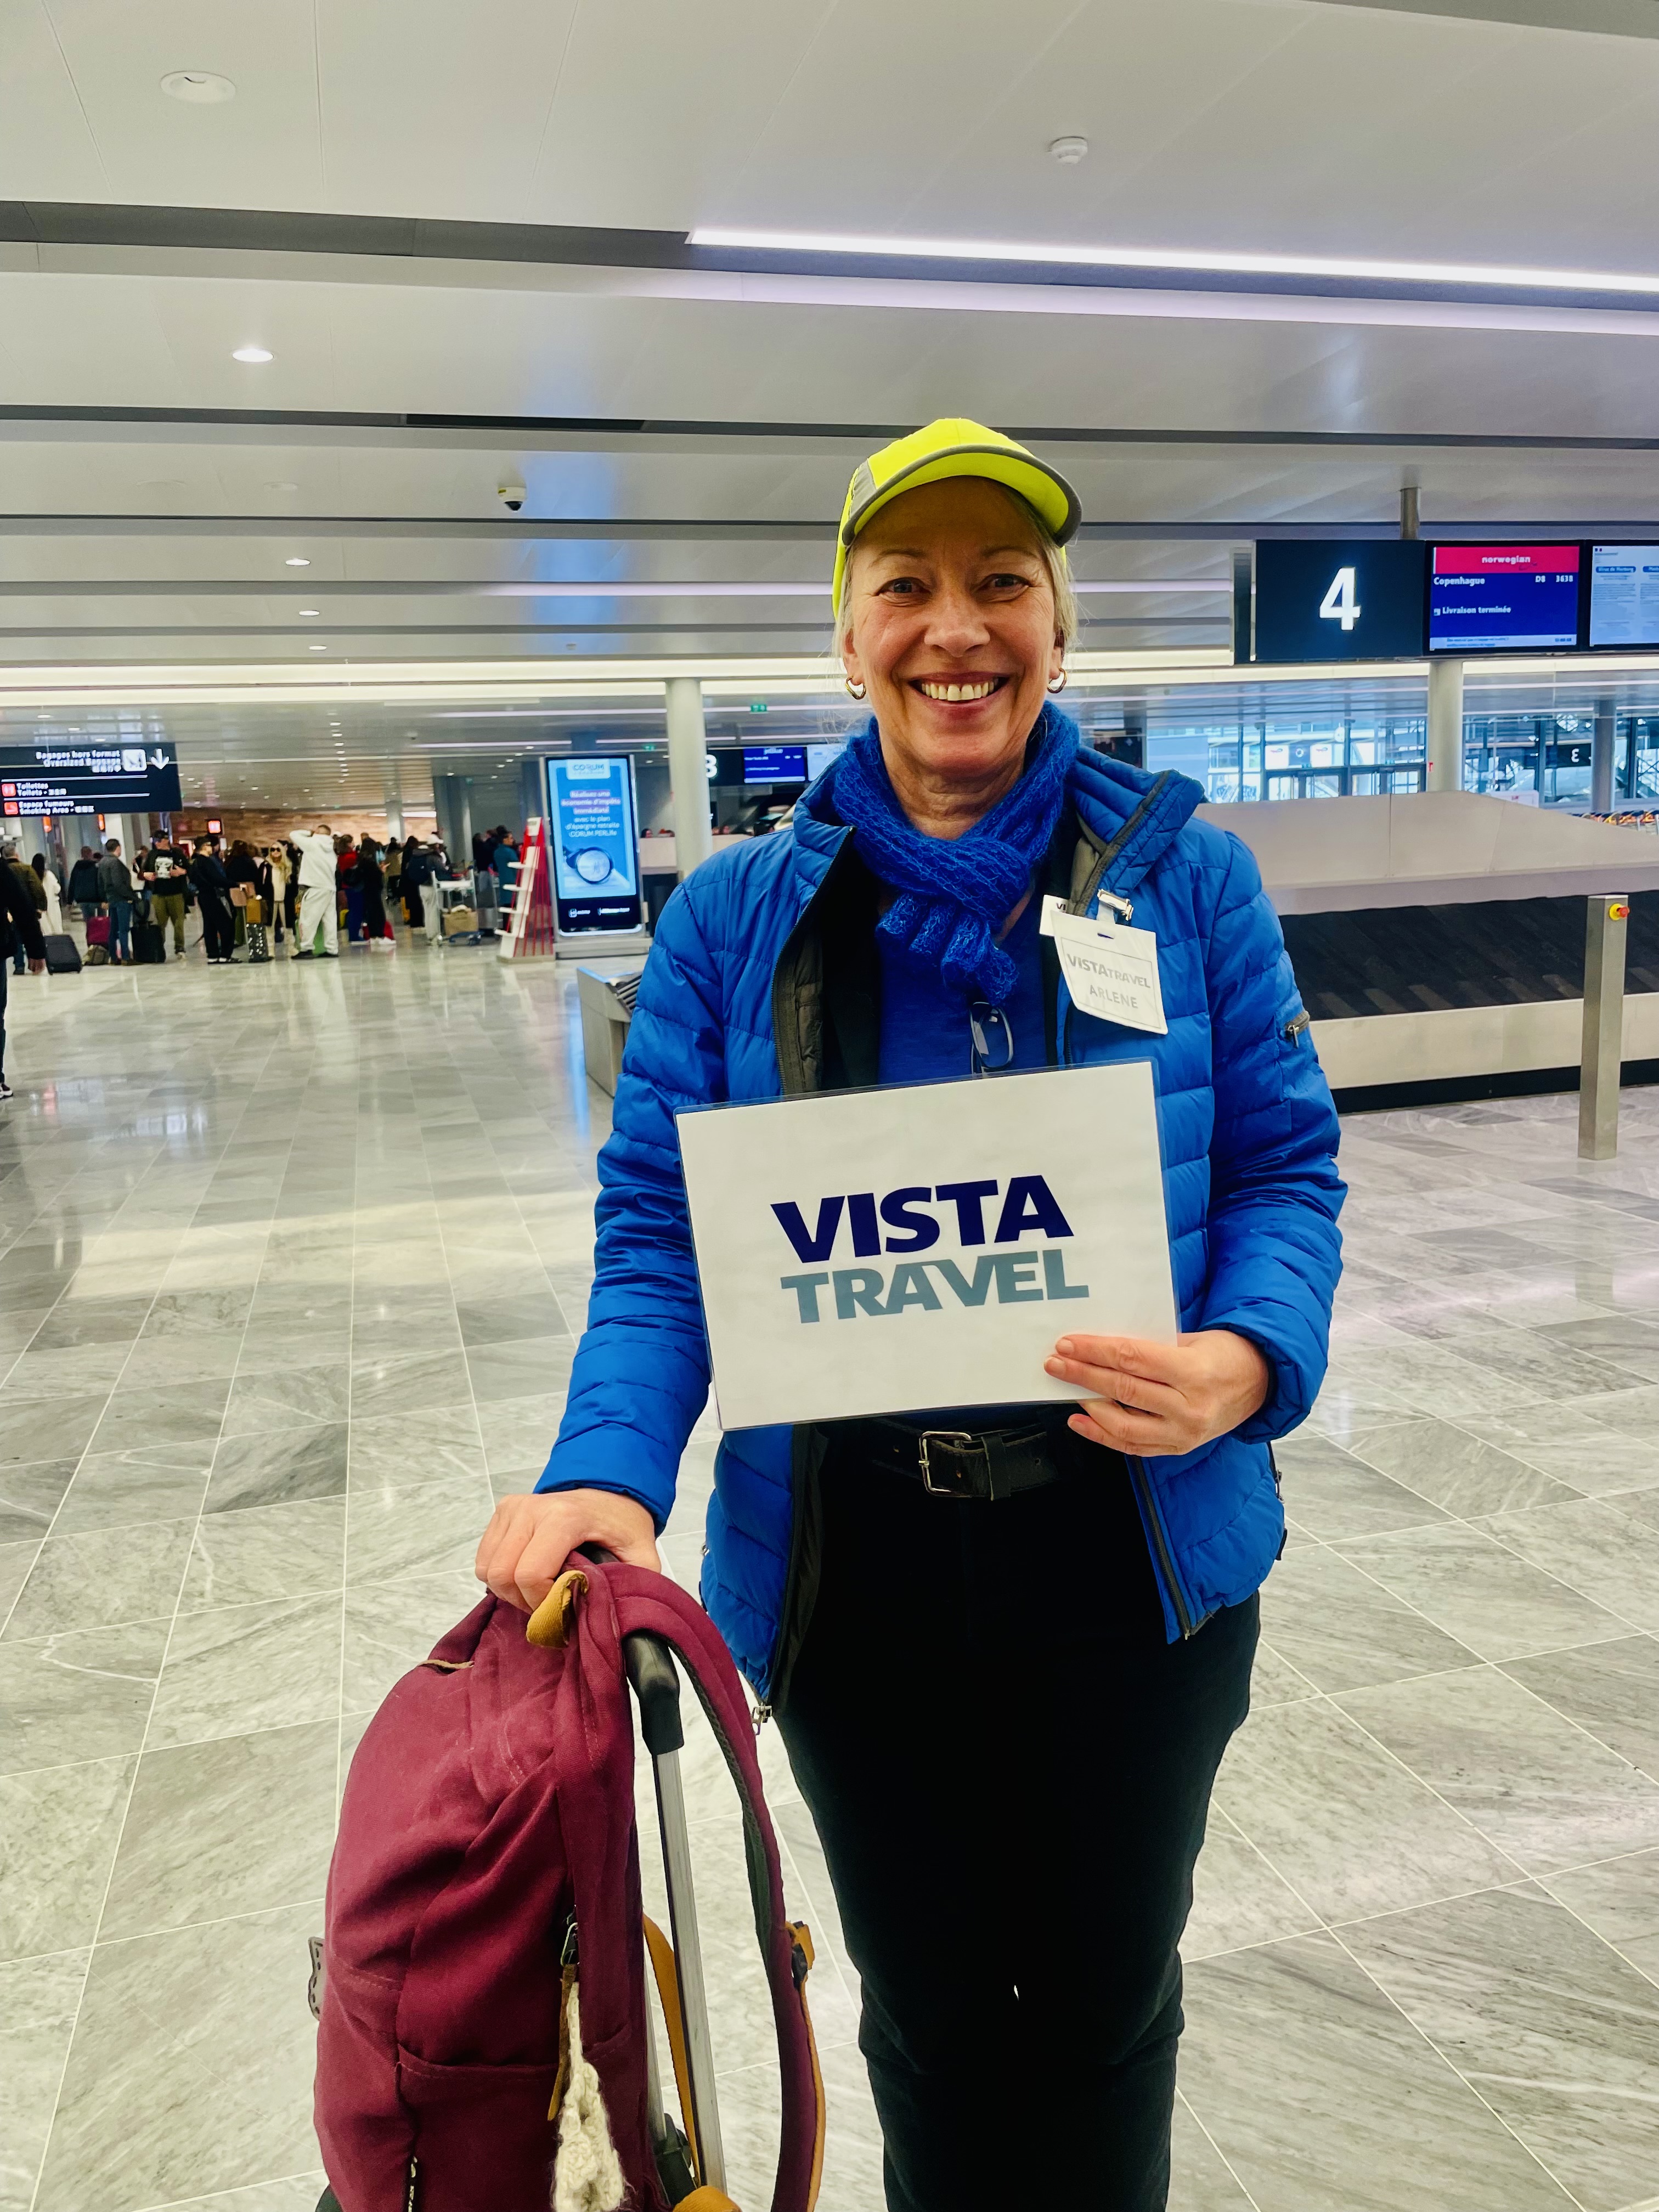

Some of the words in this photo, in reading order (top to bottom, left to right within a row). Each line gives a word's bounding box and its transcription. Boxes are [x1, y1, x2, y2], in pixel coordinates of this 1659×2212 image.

[1482, 555, 1531, 565] norwegian
[1434, 577, 1485, 587] Copenhague
[1319, 567, 1361, 631] 4
[36, 751, 71, 760] Bagages
[92, 749, 120, 758] format
[43, 758, 84, 767] Oversized
[1090, 985, 1138, 1009] ARLENE
[770, 1175, 1075, 1263] VISTA
[780, 1249, 1090, 1324] TRAVEL
